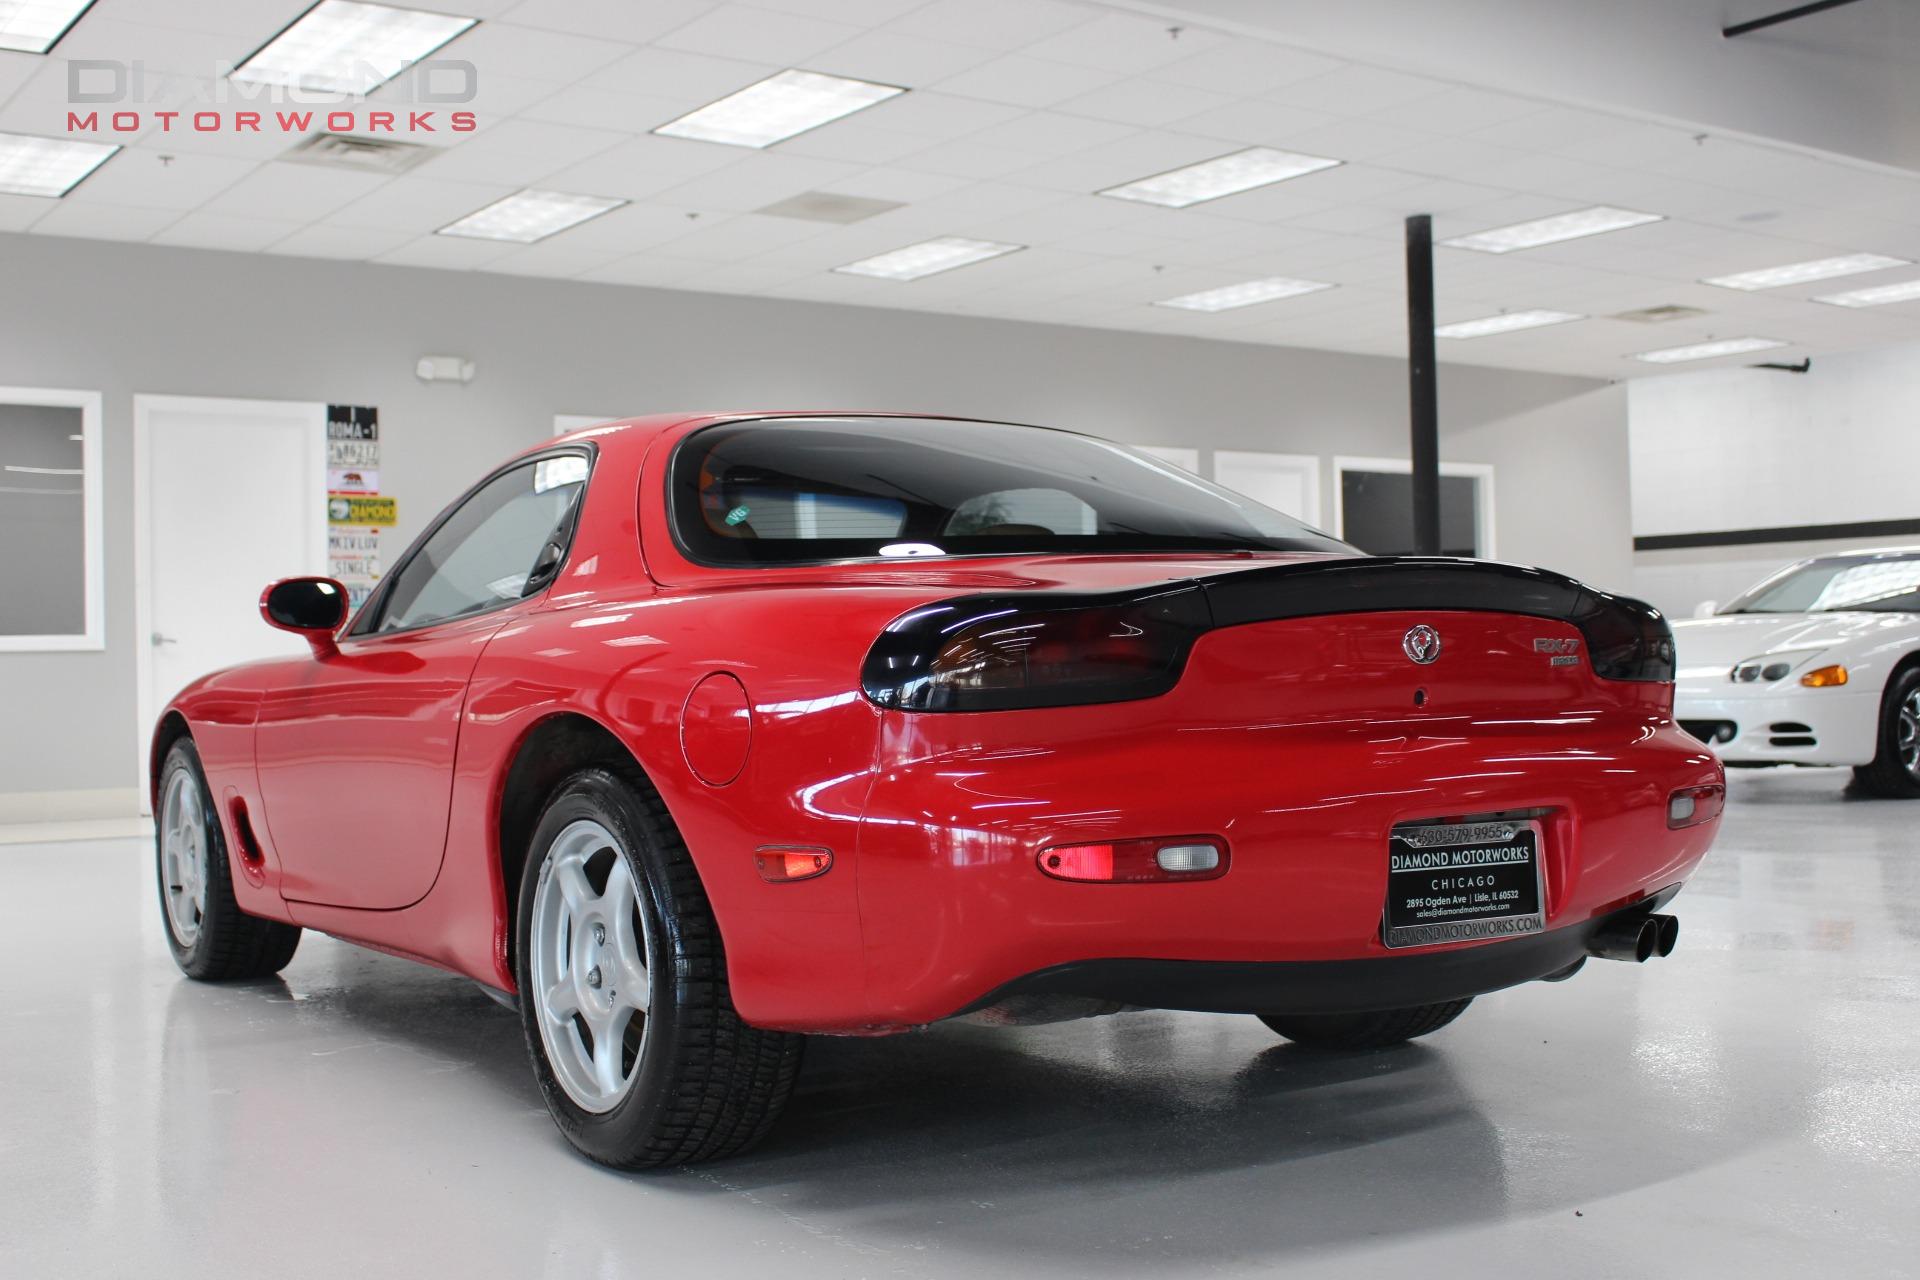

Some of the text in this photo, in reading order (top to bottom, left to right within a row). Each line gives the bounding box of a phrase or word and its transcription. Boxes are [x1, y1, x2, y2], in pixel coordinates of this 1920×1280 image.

[1534, 638, 1580, 654] RX-7
[1391, 847, 1530, 870] DIAMOND MOTORWORKS
[1431, 875, 1496, 891] CHICAGO
[1406, 899, 1424, 909] 2895
[1425, 897, 1451, 909] Ogden
[1452, 895, 1467, 905] Ave
[1491, 892, 1498, 901] IL
[1498, 890, 1520, 900] 60532
[1416, 902, 1511, 918] sales@diamondmotorworks.com
